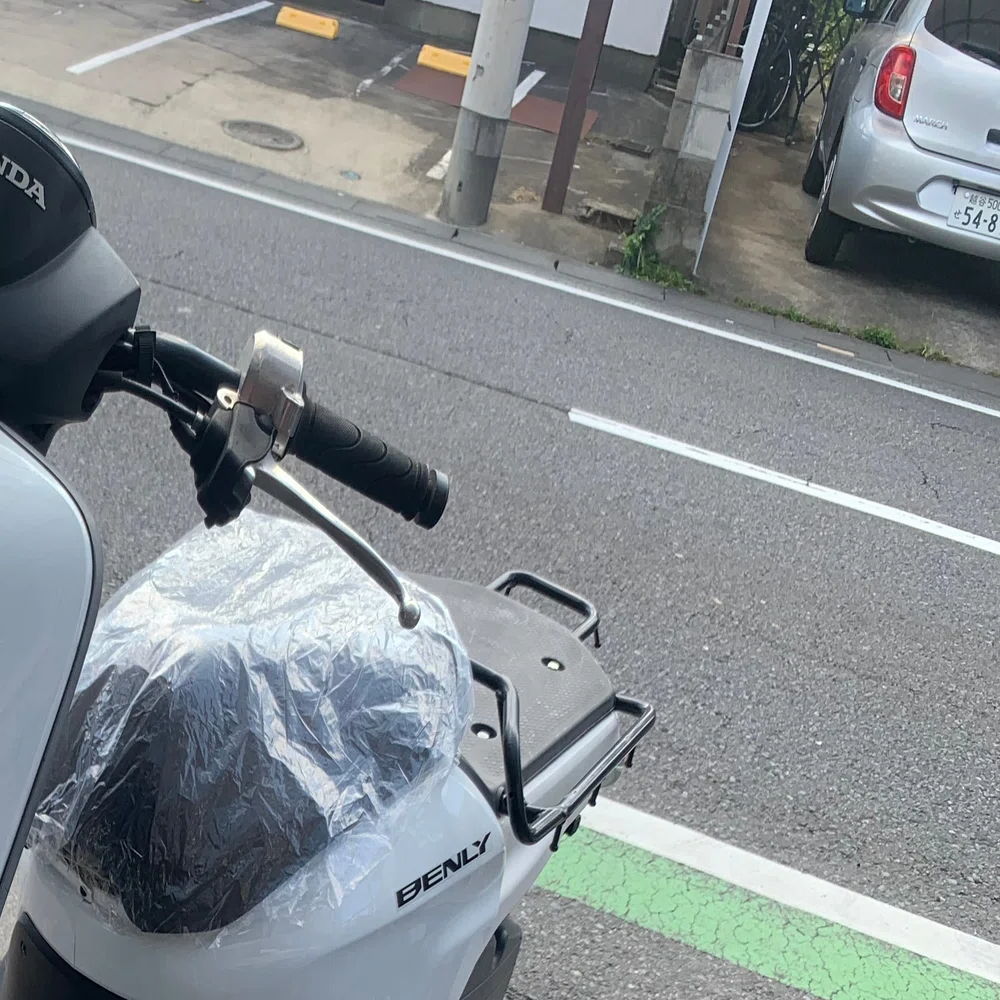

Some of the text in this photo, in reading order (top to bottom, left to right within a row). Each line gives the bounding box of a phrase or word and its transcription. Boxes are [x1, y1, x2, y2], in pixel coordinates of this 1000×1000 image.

[913, 114, 949, 131] MARCH
[961, 206, 1000, 234] 54-8
[396, 831, 491, 908] BENLY
